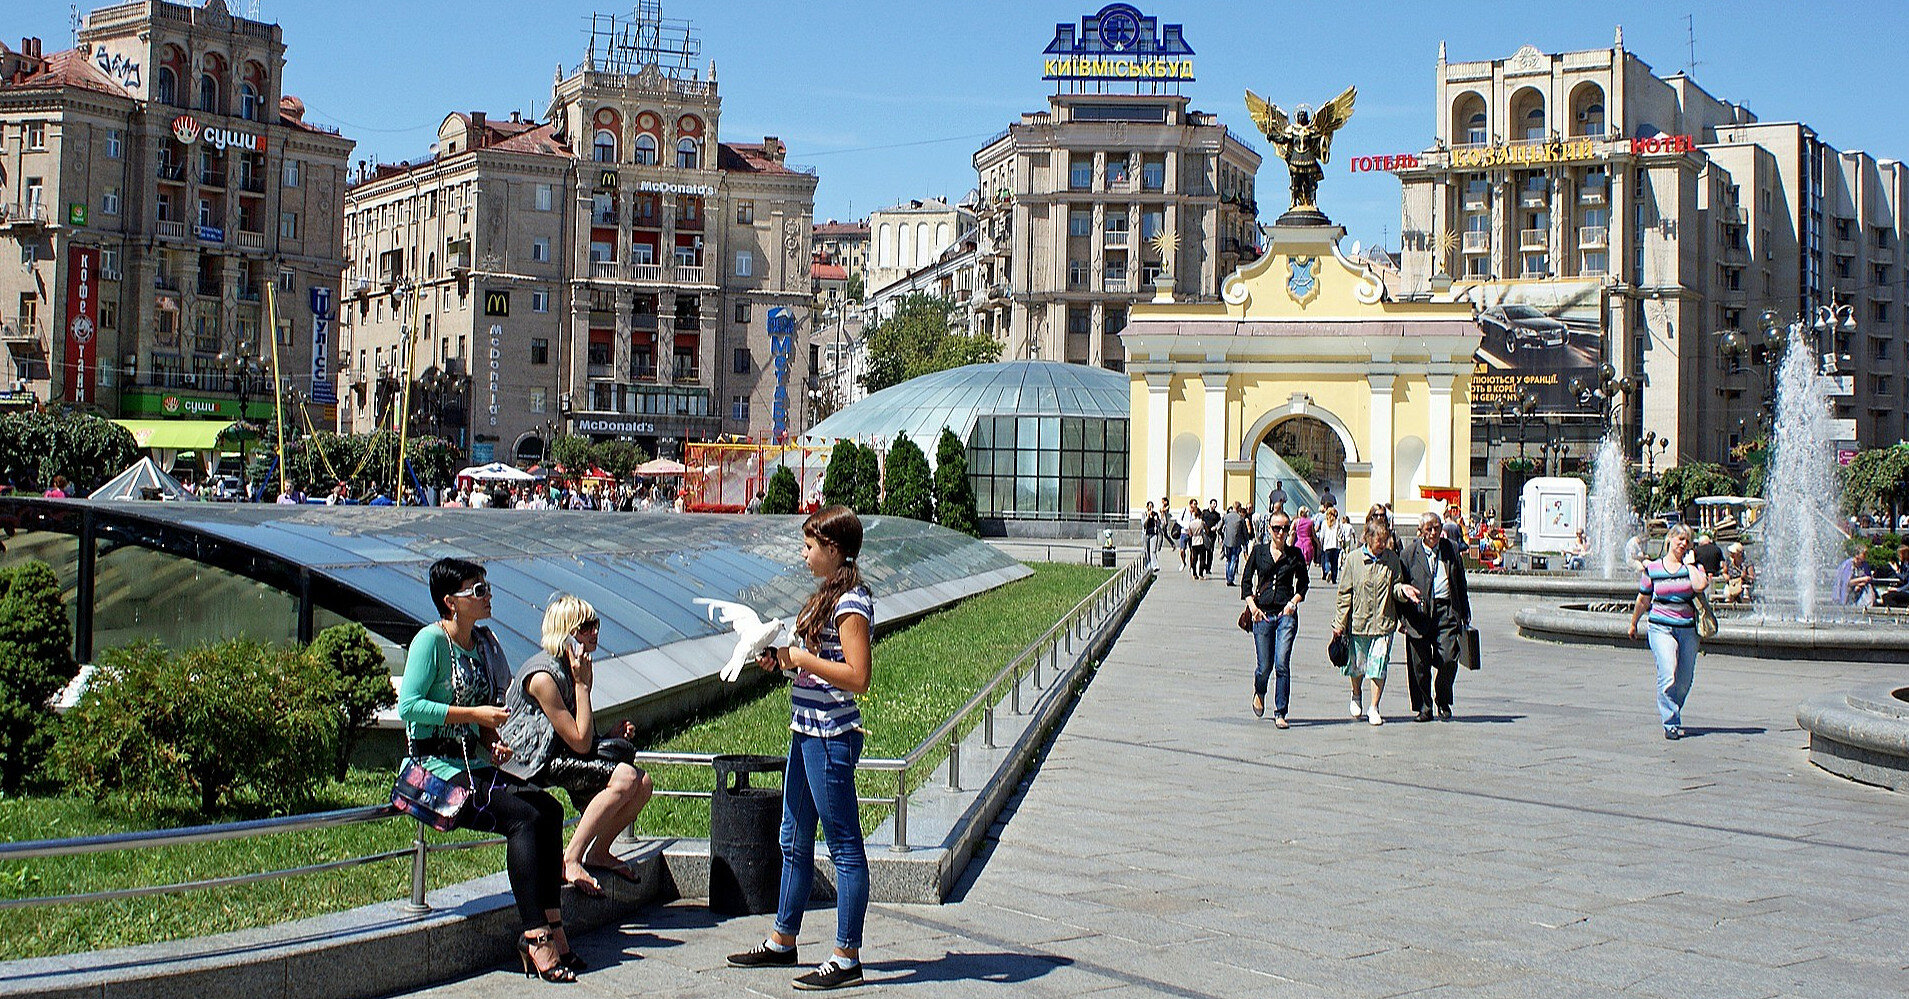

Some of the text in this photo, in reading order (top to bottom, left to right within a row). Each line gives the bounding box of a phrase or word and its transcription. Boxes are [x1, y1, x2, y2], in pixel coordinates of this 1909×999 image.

[1044, 56, 1194, 79] КИЇВМІСЬКБУД
[1453, 138, 1595, 168] КОЗАЦЬКИЙ
[1630, 134, 1698, 155] HOTEL
[1351, 154, 1419, 172] ГОТЕЛЬ
[640, 181, 714, 195] McDonald's
[489, 325, 502, 426] McDonald's
[1471, 375, 1514, 385] ЛЮЮТЬСЯ
[578, 419, 655, 433] McDonald's
